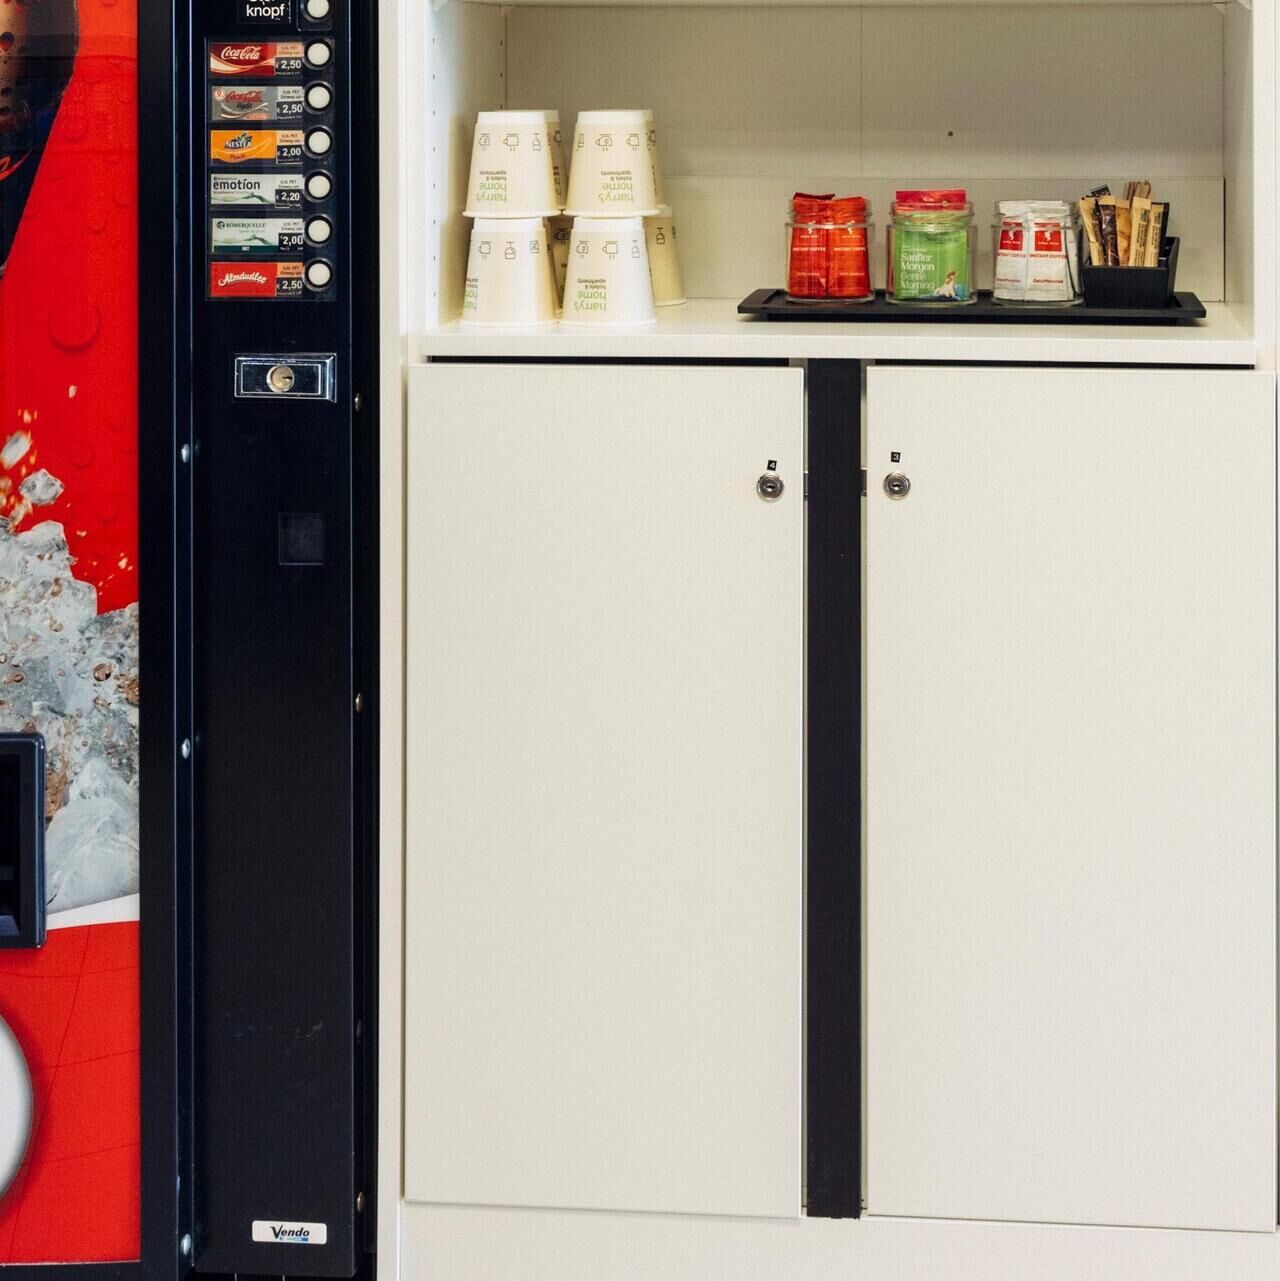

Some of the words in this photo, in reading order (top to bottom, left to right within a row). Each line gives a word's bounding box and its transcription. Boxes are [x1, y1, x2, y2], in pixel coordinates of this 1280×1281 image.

[246, 4, 285, 19] knopf
[280, 60, 302, 70] 2,50
[282, 104, 303, 114] 2,50
[282, 148, 302, 157] 2,00
[480, 181, 507, 192] home
[602, 181, 633, 193] home
[281, 192, 300, 201] 2,20
[282, 236, 303, 245] 2,00
[219, 272, 268, 287] Almdudler
[282, 281, 303, 290] 2,50
[577, 289, 607, 300] home
[270, 1224, 310, 1239] Vendo
